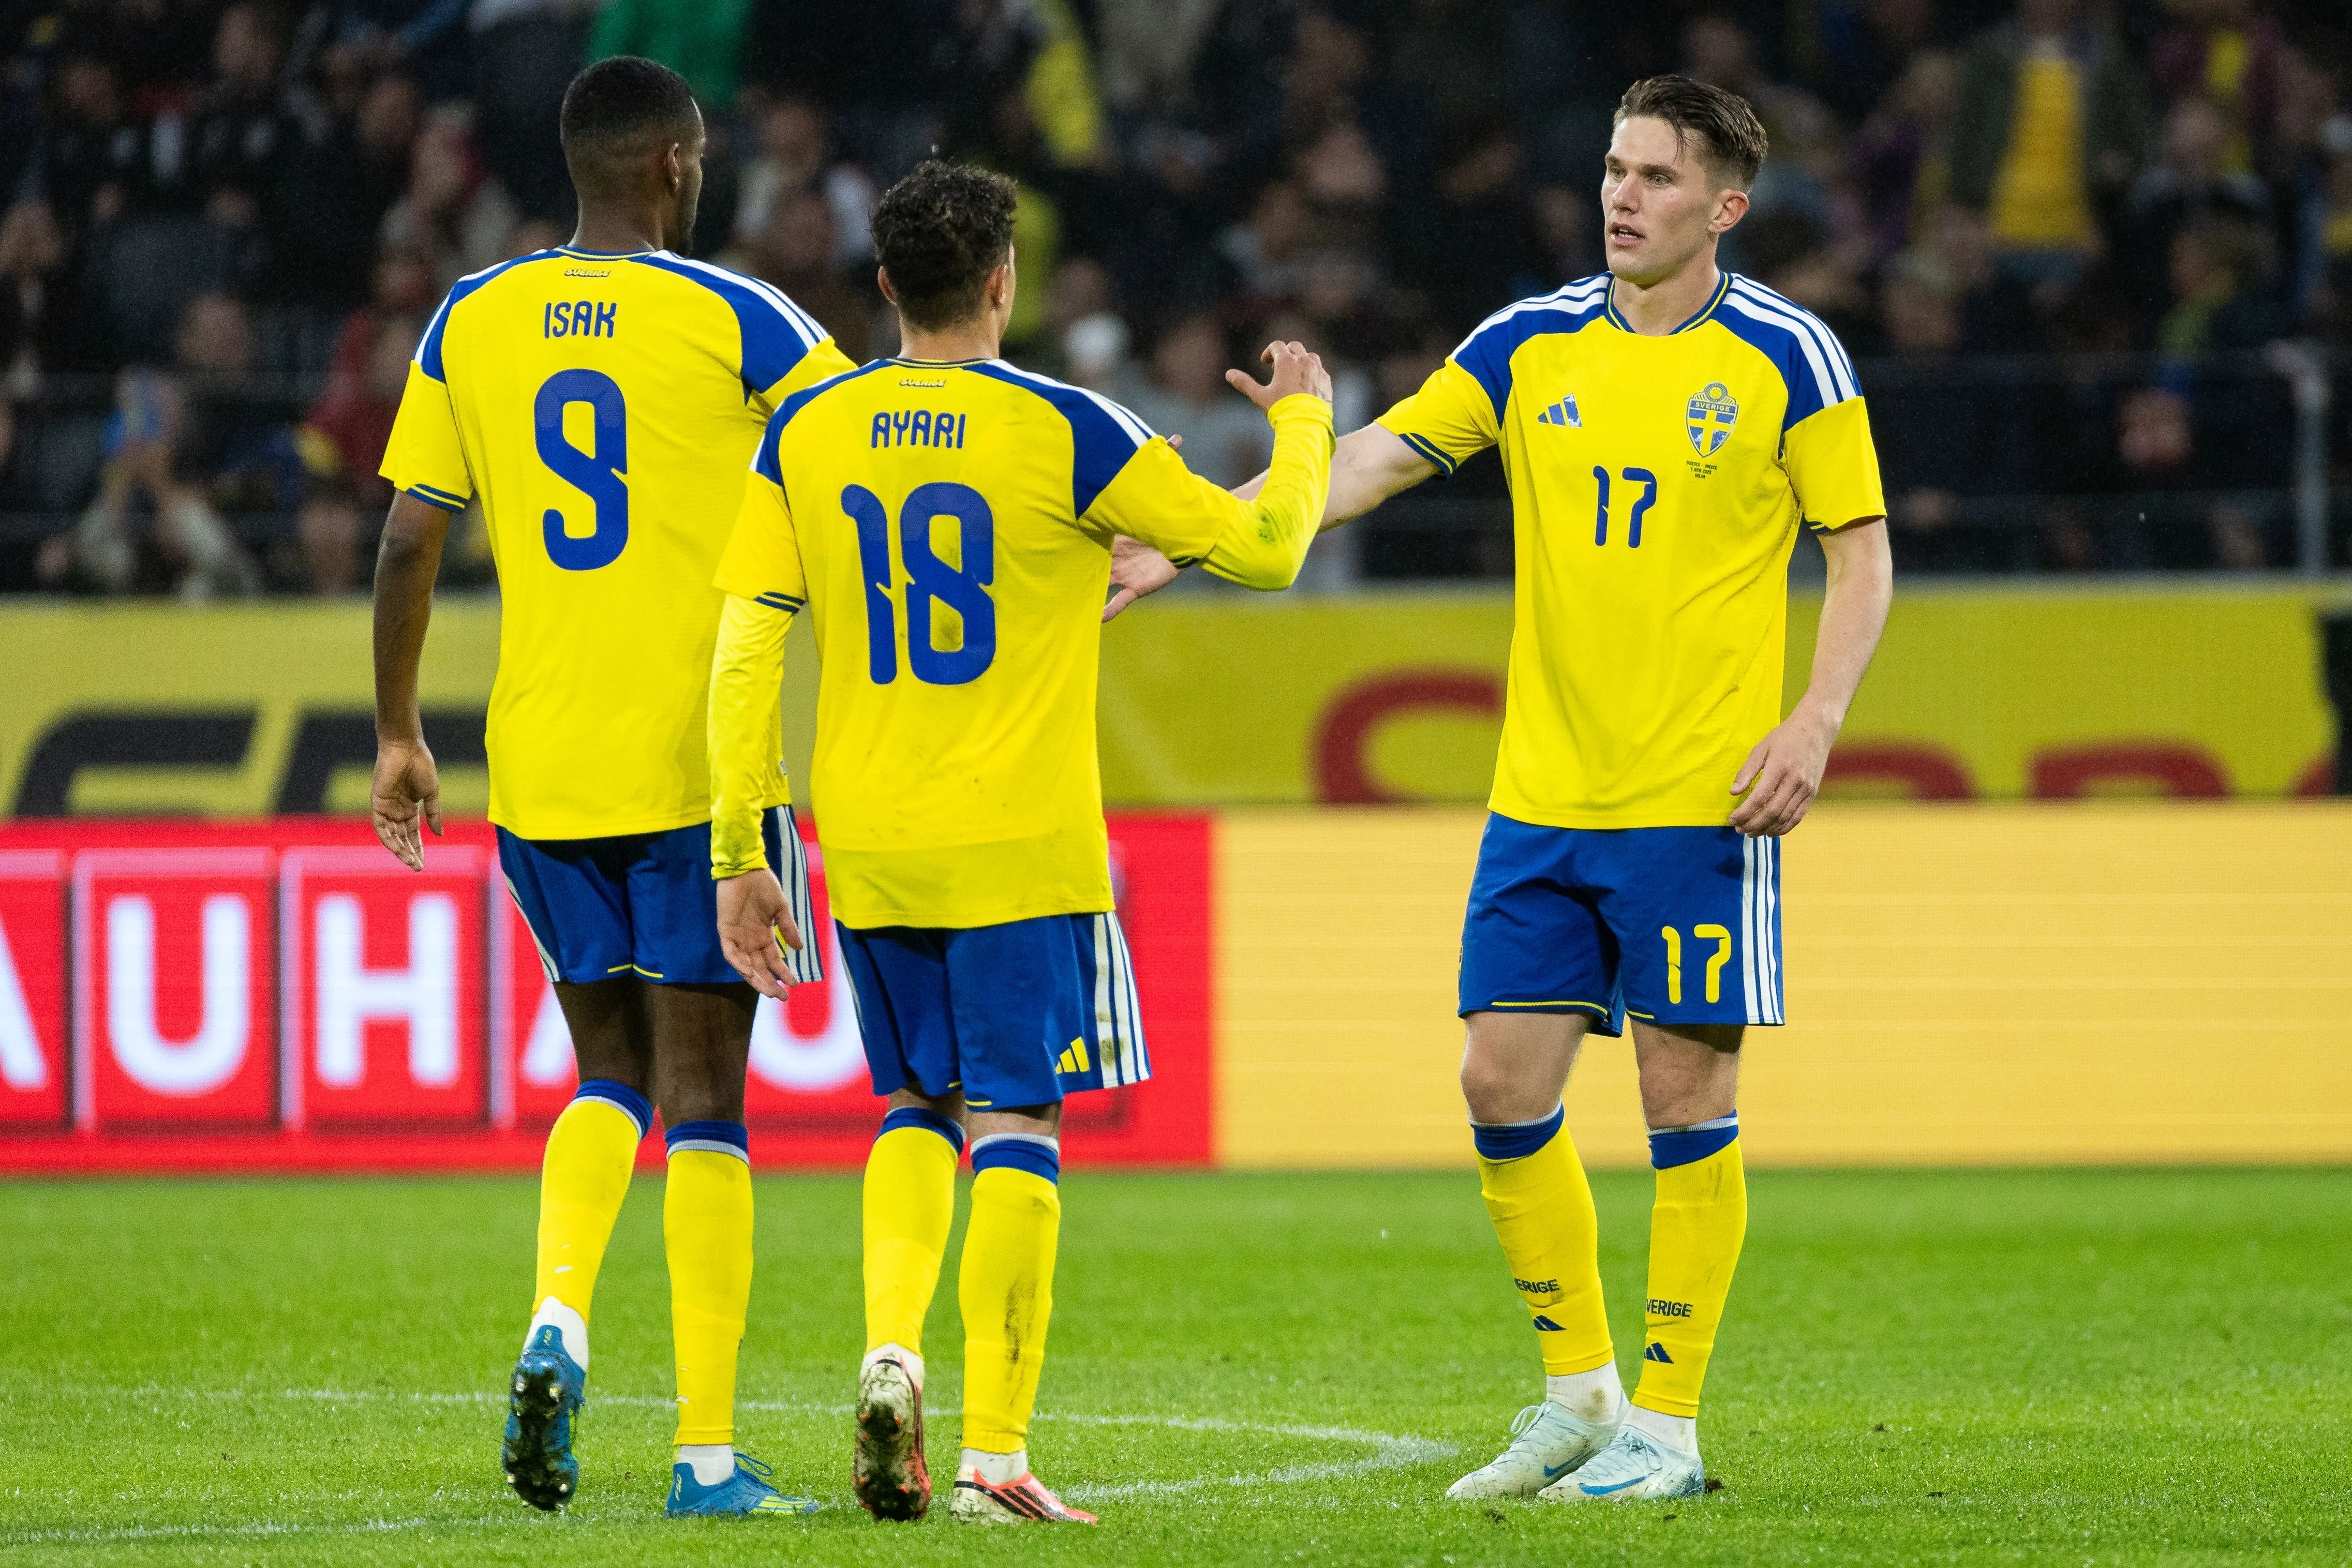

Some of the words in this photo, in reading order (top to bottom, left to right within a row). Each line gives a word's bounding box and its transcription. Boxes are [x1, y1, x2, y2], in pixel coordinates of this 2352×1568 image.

[564, 268, 611, 277] SVERIGE
[544, 301, 617, 339] ISAK
[1695, 401, 1731, 412] SVERIGE
[871, 410, 966, 449] AYARI
[534, 368, 629, 571] 9
[1593, 466, 1657, 548] 17
[841, 482, 996, 685] 18
[1662, 924, 1732, 1004] 17
[1514, 1278, 1560, 1293] ERIGE
